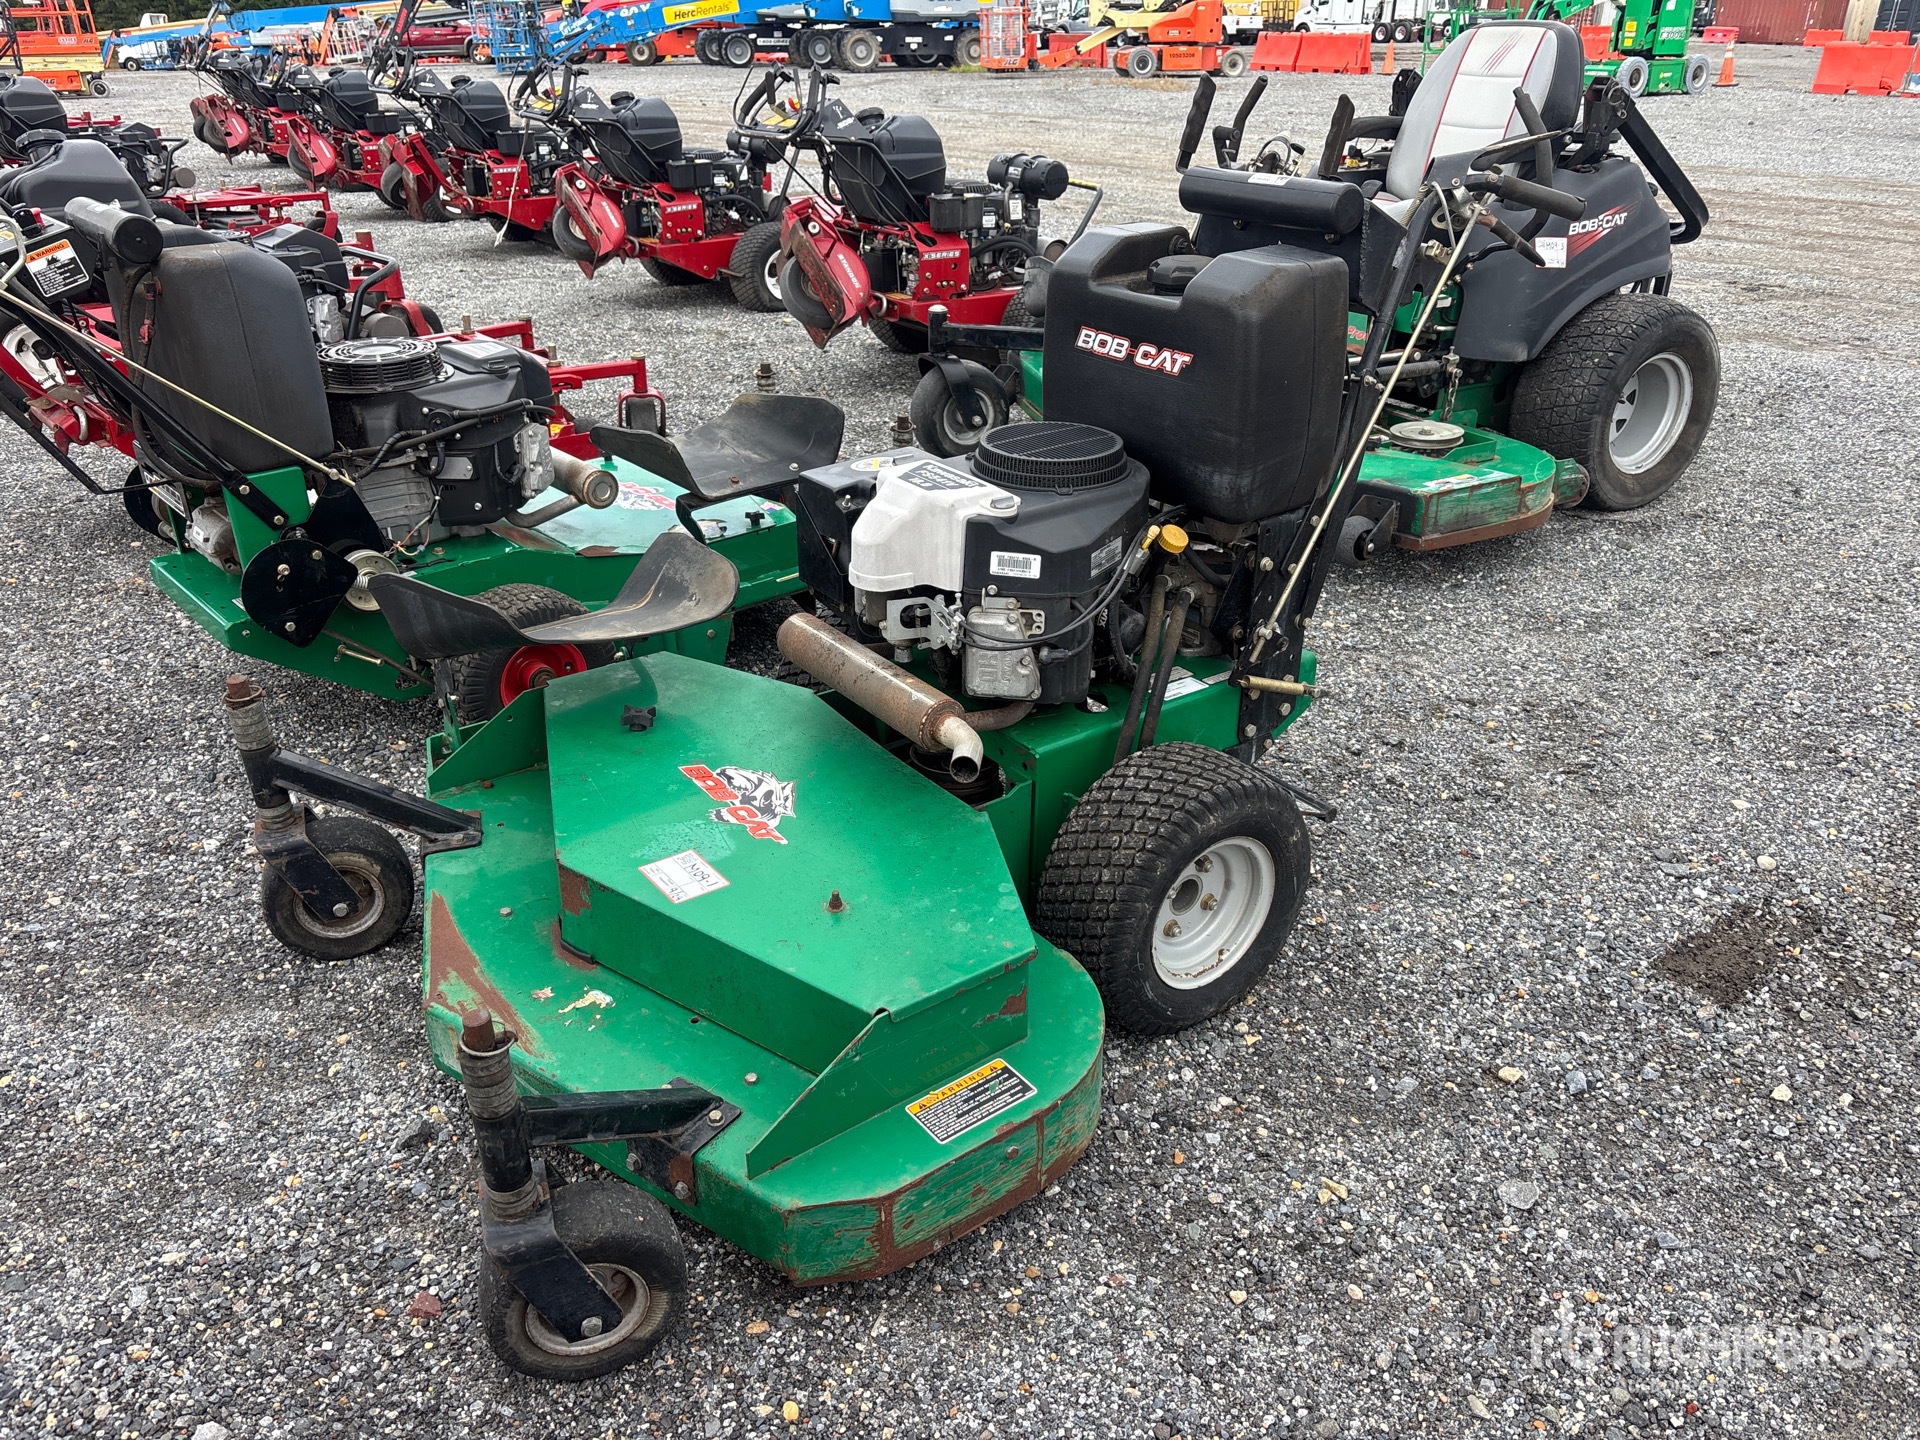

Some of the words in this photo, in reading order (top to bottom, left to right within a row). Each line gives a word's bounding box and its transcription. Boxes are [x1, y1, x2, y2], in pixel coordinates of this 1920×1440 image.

[674, 3, 730, 20] HercRentals
[1004, 58, 1019, 66] JLG
[1568, 212, 1628, 236] BOB-CAT
[35, 243, 66, 259] WARNING
[1075, 326, 1194, 377] BOB-CAT
